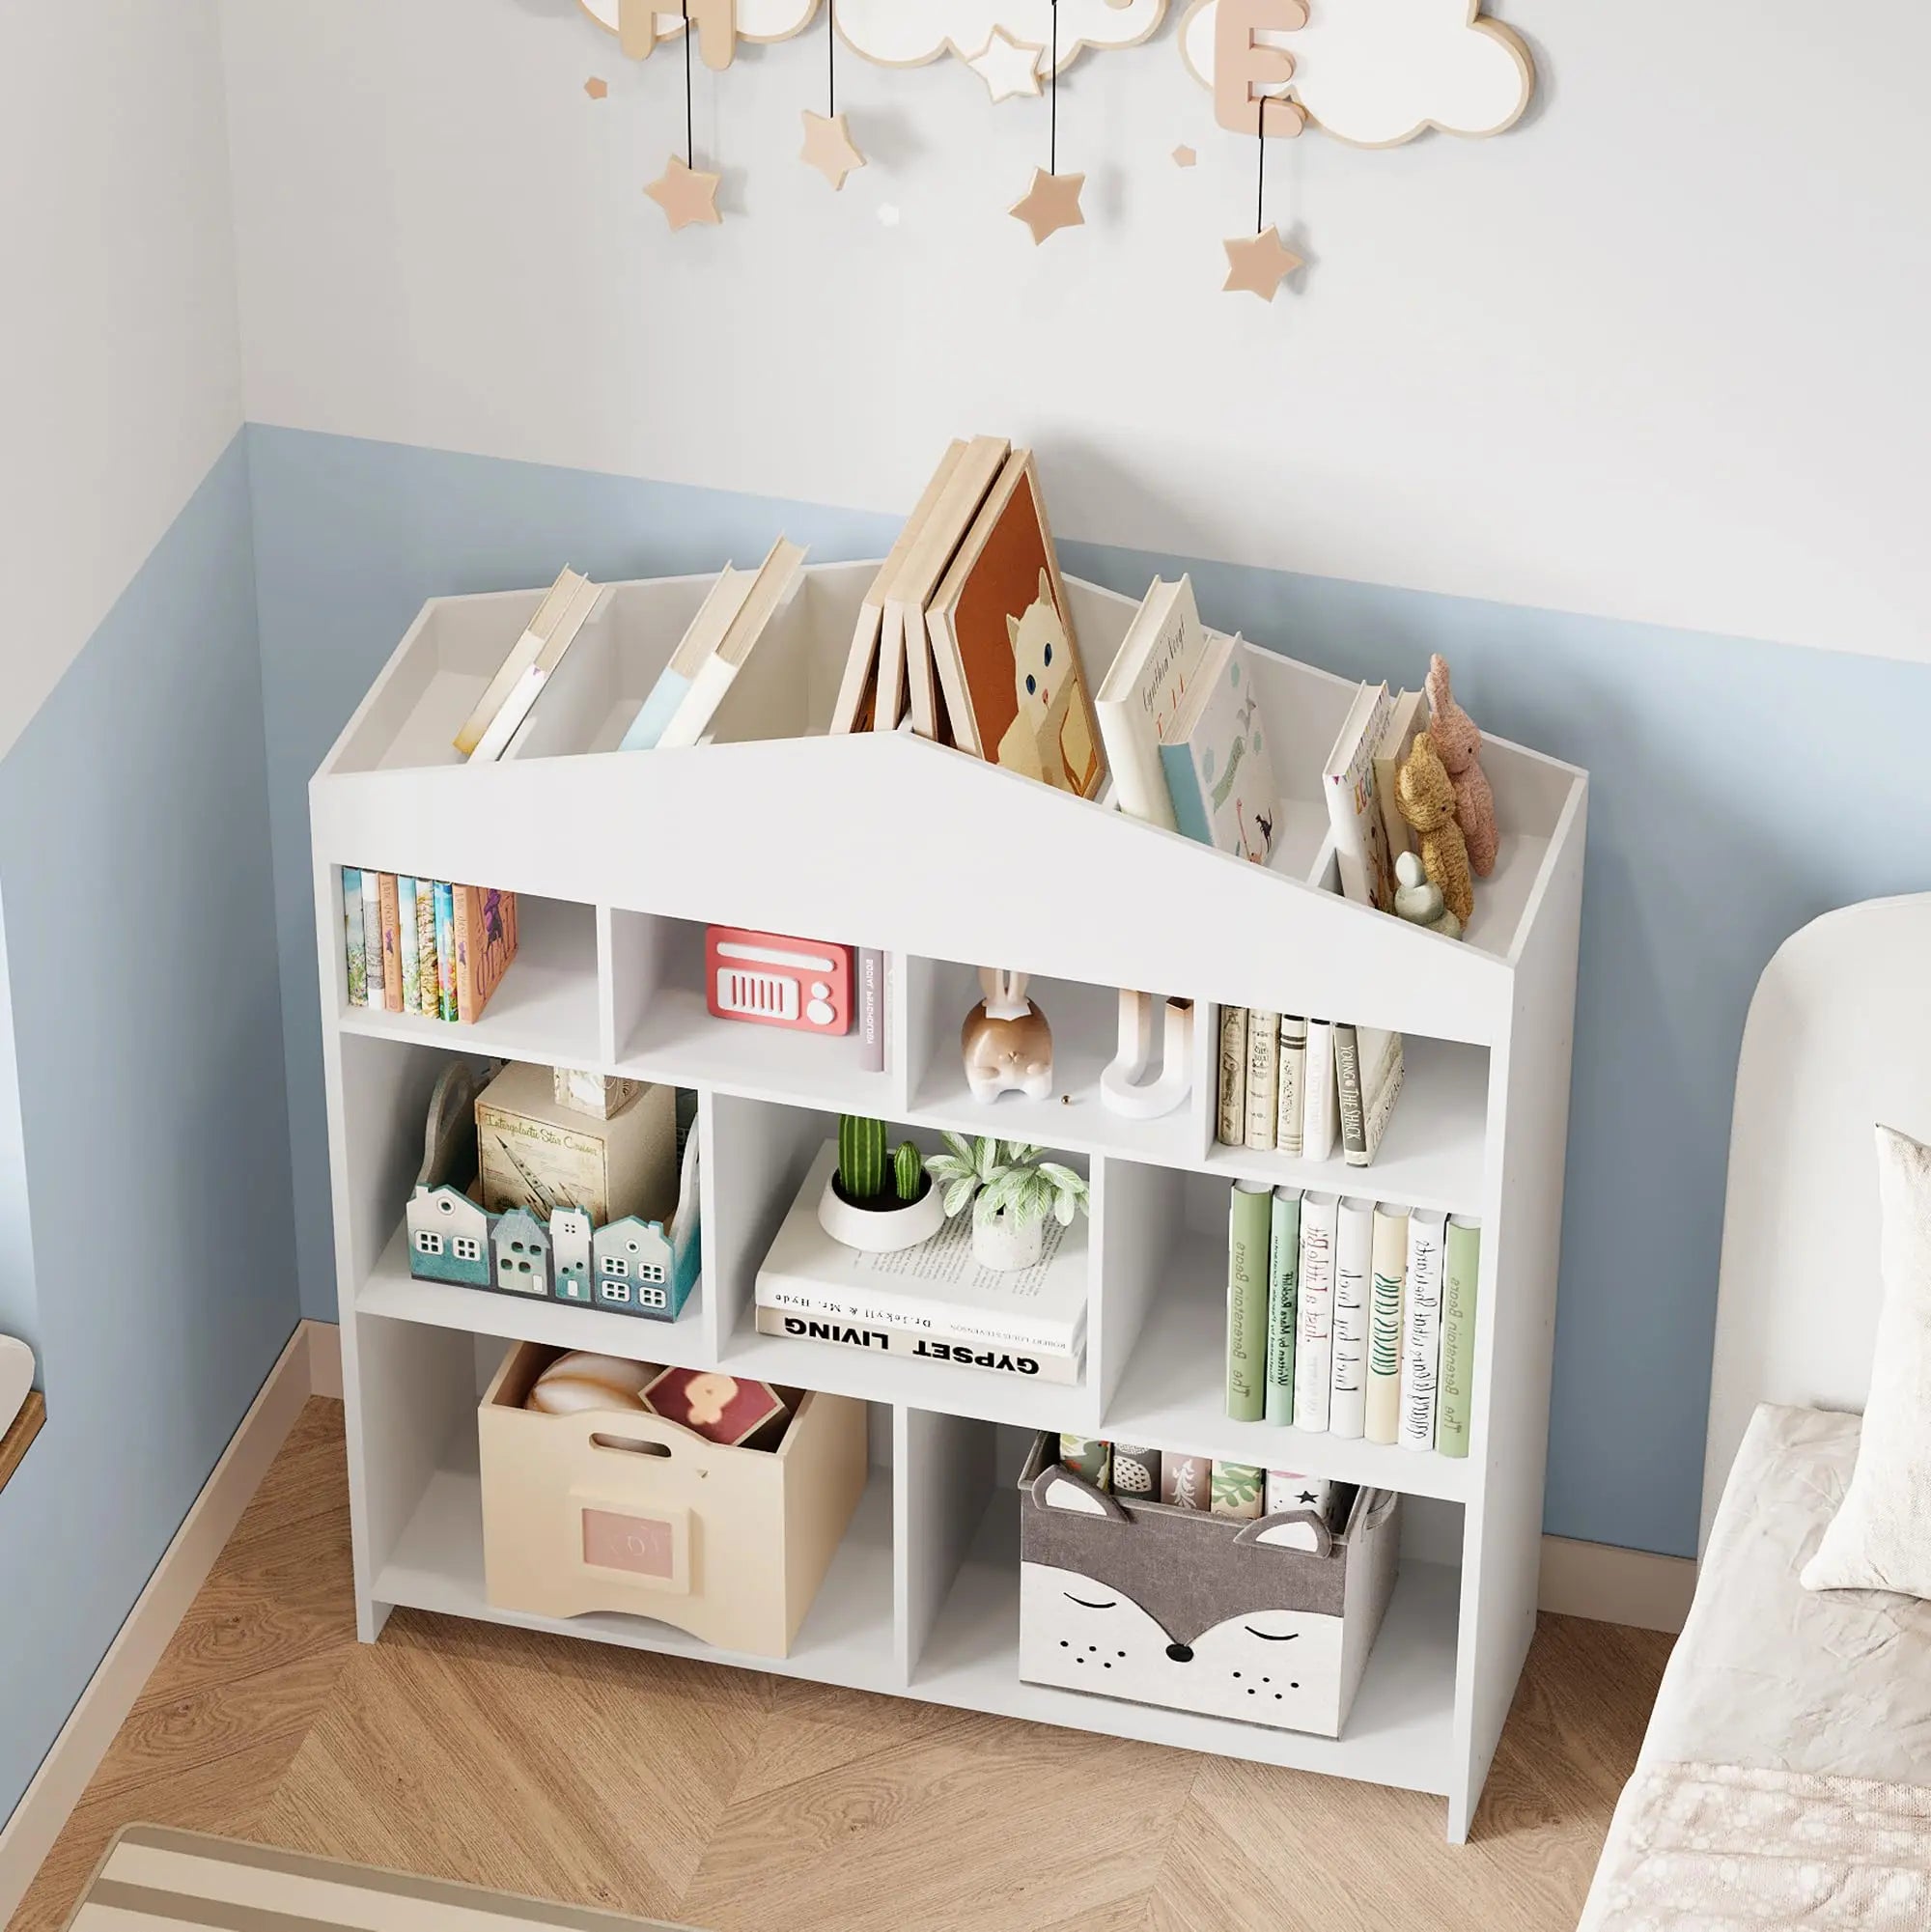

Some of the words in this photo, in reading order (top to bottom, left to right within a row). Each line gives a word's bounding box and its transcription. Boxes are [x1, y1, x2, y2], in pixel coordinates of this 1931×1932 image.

[1340, 1045, 1356, 1079] YOUNG
[1342, 1088, 1359, 1108] THE
[1344, 1109, 1362, 1140] SHACK
[540, 1129, 563, 1145] Star
[563, 1136, 599, 1156] Cruiser
[773, 1293, 810, 1307] Hyde
[783, 1316, 889, 1350] LIVING
[911, 1339, 1040, 1376] GYPSET
